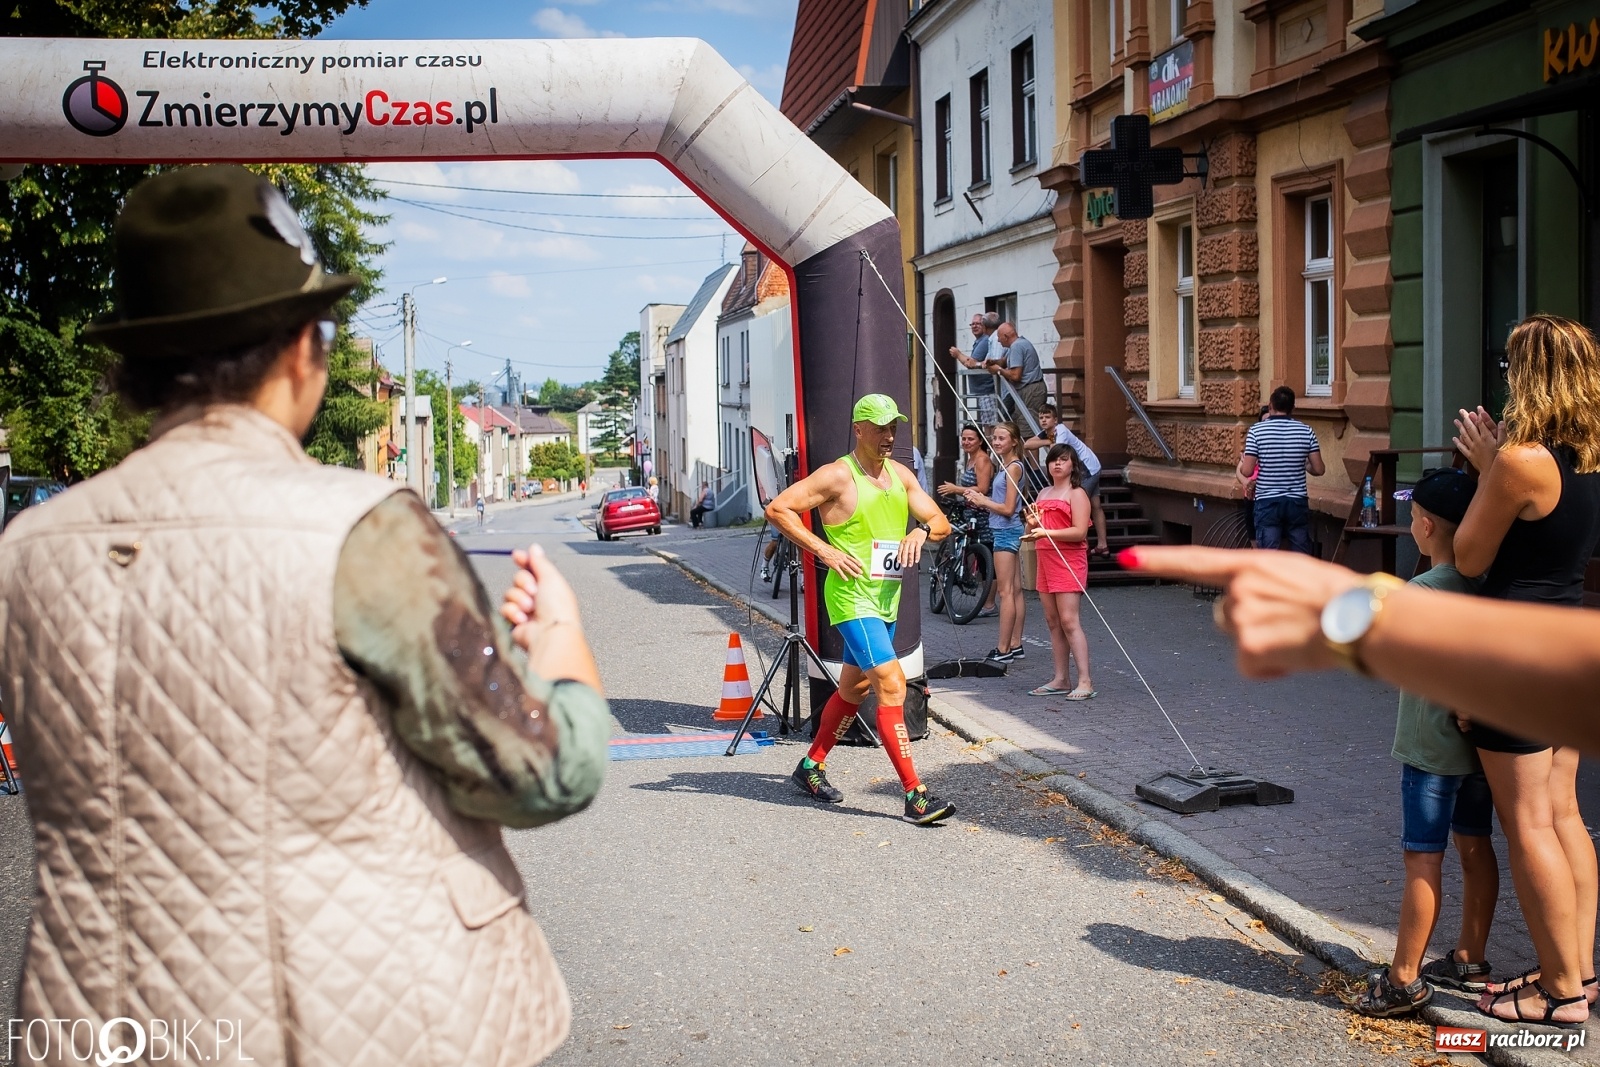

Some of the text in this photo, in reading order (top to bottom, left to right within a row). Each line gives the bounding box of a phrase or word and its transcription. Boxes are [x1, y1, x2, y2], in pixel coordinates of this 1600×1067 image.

[143, 51, 482, 74] Elektroniczny pomiar czasu
[136, 87, 498, 136] ZmierzymyCzas.pl
